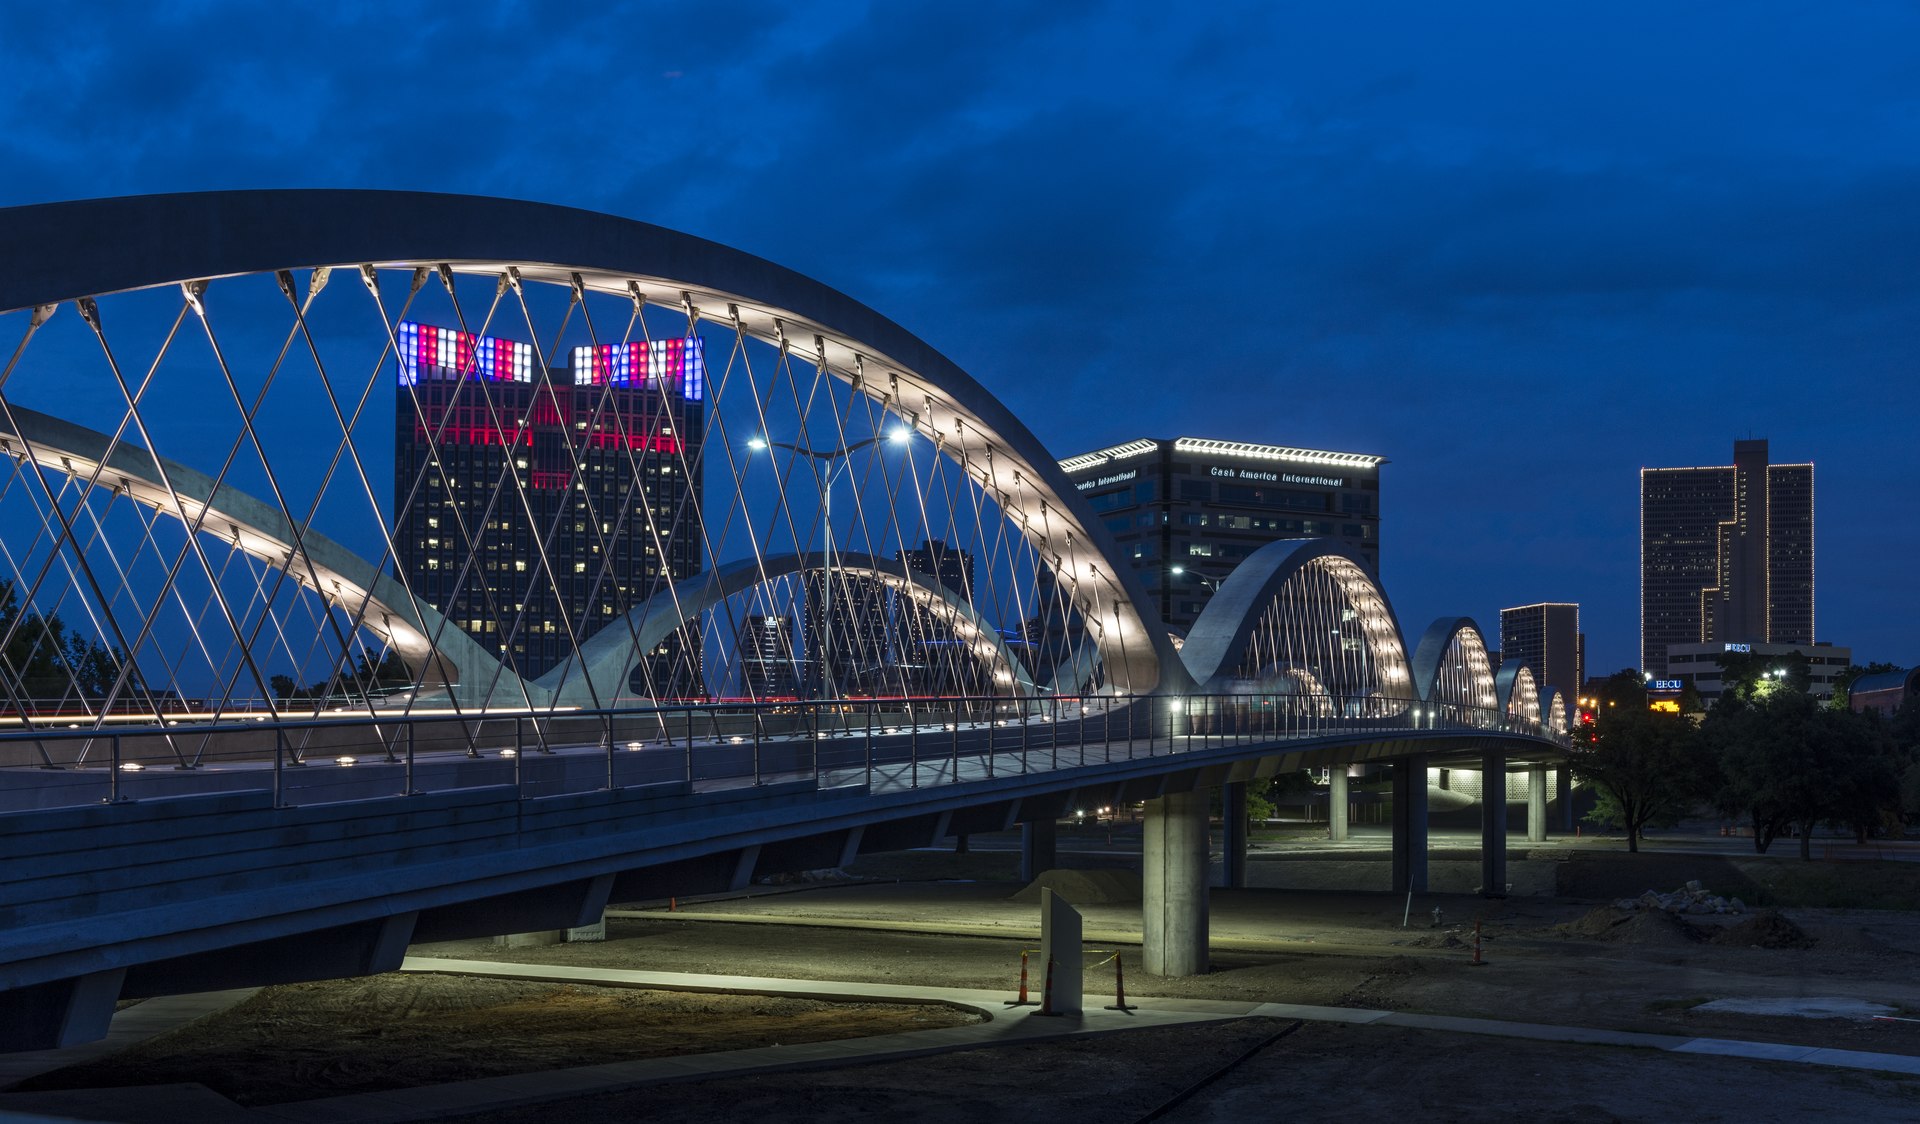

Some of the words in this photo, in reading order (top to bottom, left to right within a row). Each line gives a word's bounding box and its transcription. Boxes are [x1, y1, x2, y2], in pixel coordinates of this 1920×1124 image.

[1211, 466, 1235, 478] Cash
[1240, 469, 1277, 481] America
[1282, 473, 1343, 486] International
[1656, 680, 1681, 689] EECU
